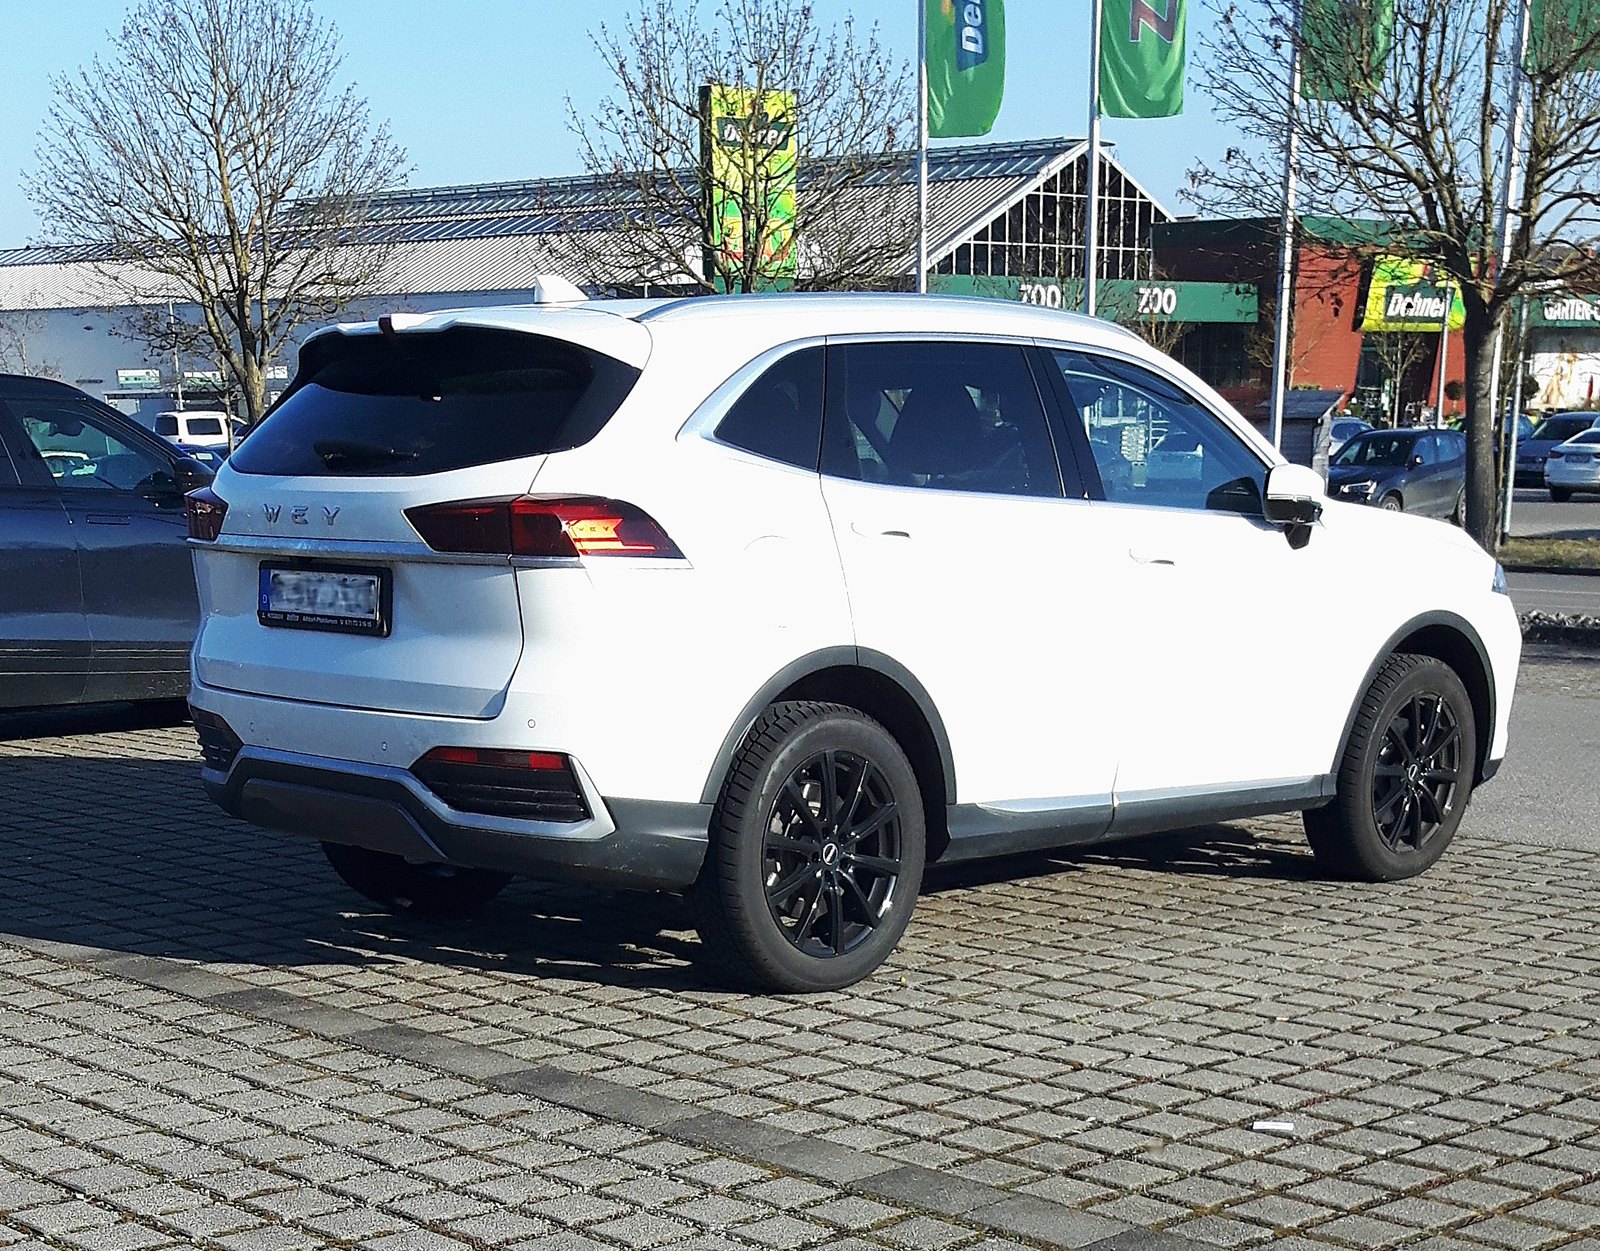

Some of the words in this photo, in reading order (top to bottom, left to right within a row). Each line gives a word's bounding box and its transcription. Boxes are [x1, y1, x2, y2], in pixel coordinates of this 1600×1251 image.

[961, 0, 983, 54] De
[1019, 284, 1062, 308] ZOO
[1138, 287, 1177, 314] ZOO
[263, 503, 341, 526] WEY
